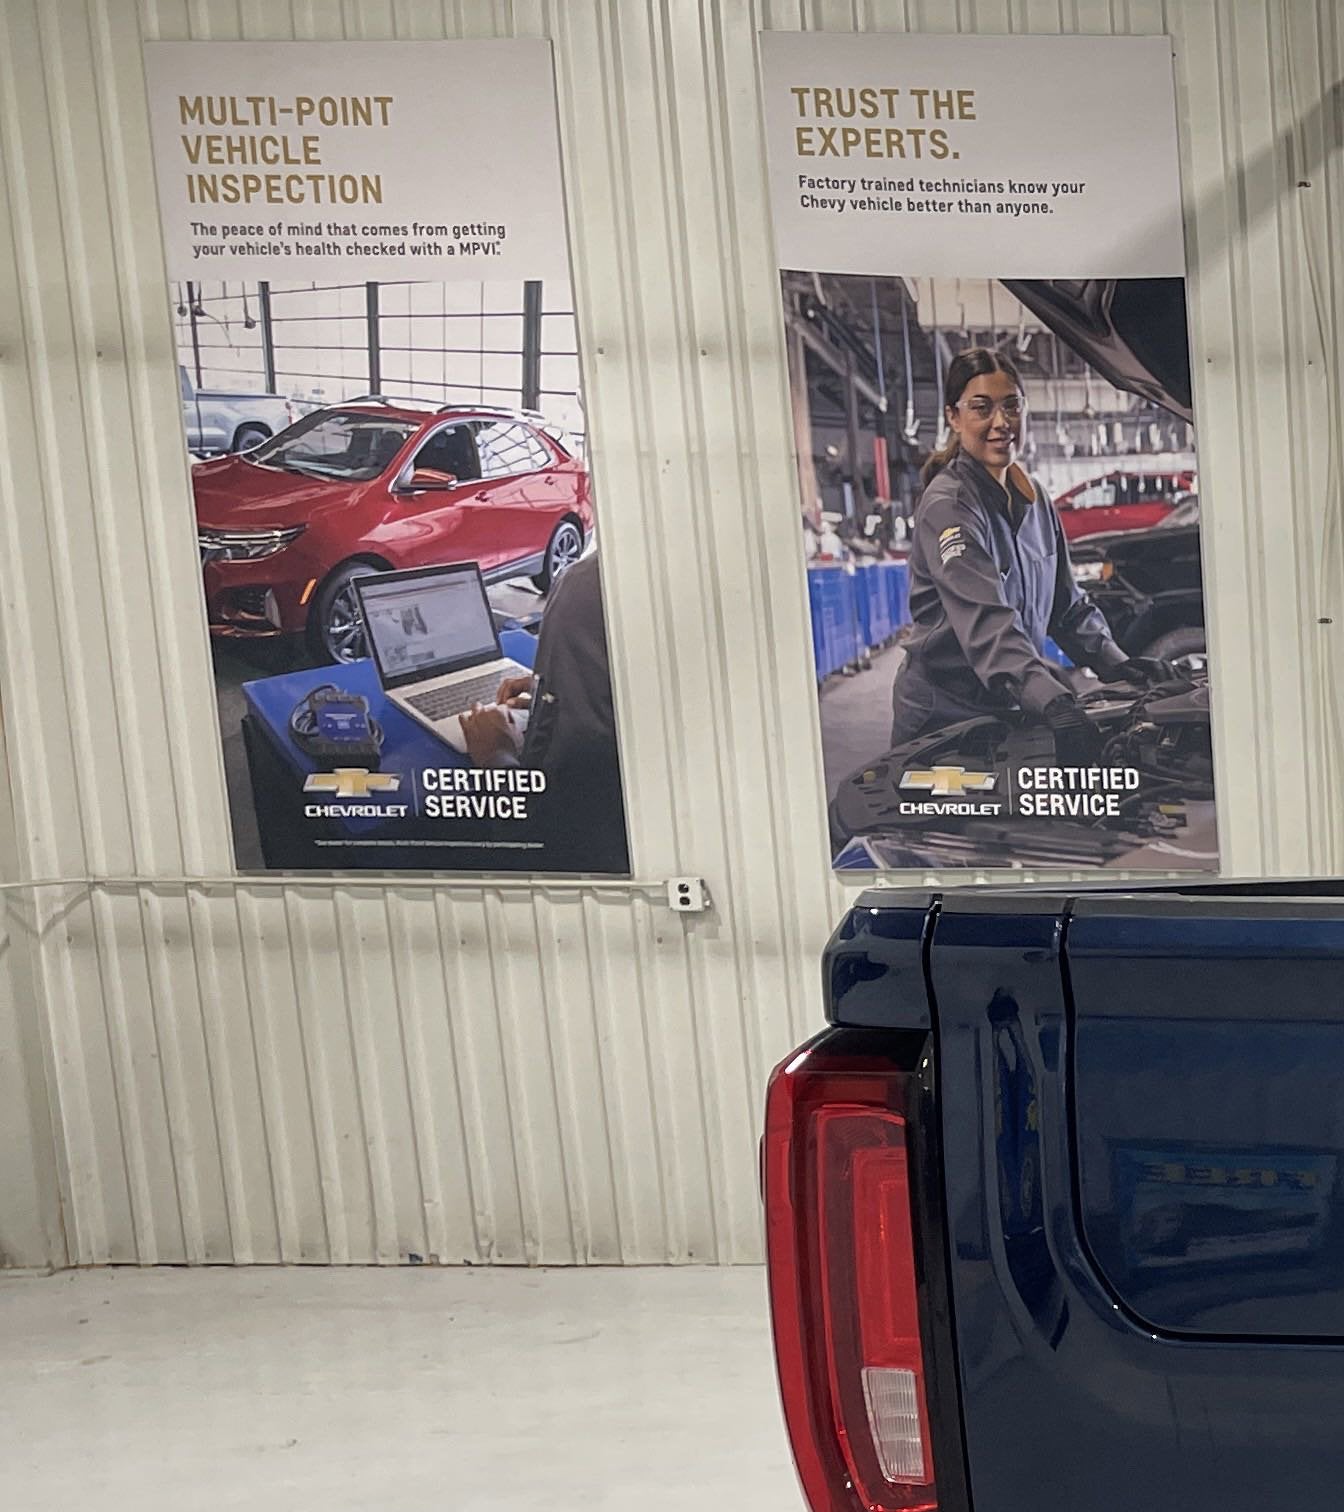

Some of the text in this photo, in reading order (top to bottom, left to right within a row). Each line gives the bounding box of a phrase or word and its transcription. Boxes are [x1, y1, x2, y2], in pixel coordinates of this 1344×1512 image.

[178, 95, 393, 126] MULTI-POINT
[790, 87, 976, 120] TRUST THE
[181, 135, 321, 165] VEHICLE
[796, 127, 960, 159] EXPERTS.
[186, 174, 382, 204] INSPECTION
[798, 175, 1085, 197] Factory trained technicians know your
[800, 194, 1053, 217] Chevy vehicle better than anyone.
[190, 222, 505, 240] The peace of mind that comes from getting
[192, 245, 226, 259] your
[229, 241, 291, 255] vehicle's
[295, 242, 341, 256] health
[346, 241, 406, 256] checked
[410, 242, 442, 255] with
[447, 245, 455, 255] a
[423, 768, 546, 792] CERTIFIED
[1018, 767, 1139, 789] CERTIFIED
[305, 805, 408, 817] CHEVROLET
[425, 795, 527, 818] SERVICE
[900, 803, 1002, 815] CHEVROLET
[1019, 793, 1120, 816] SERVICE
